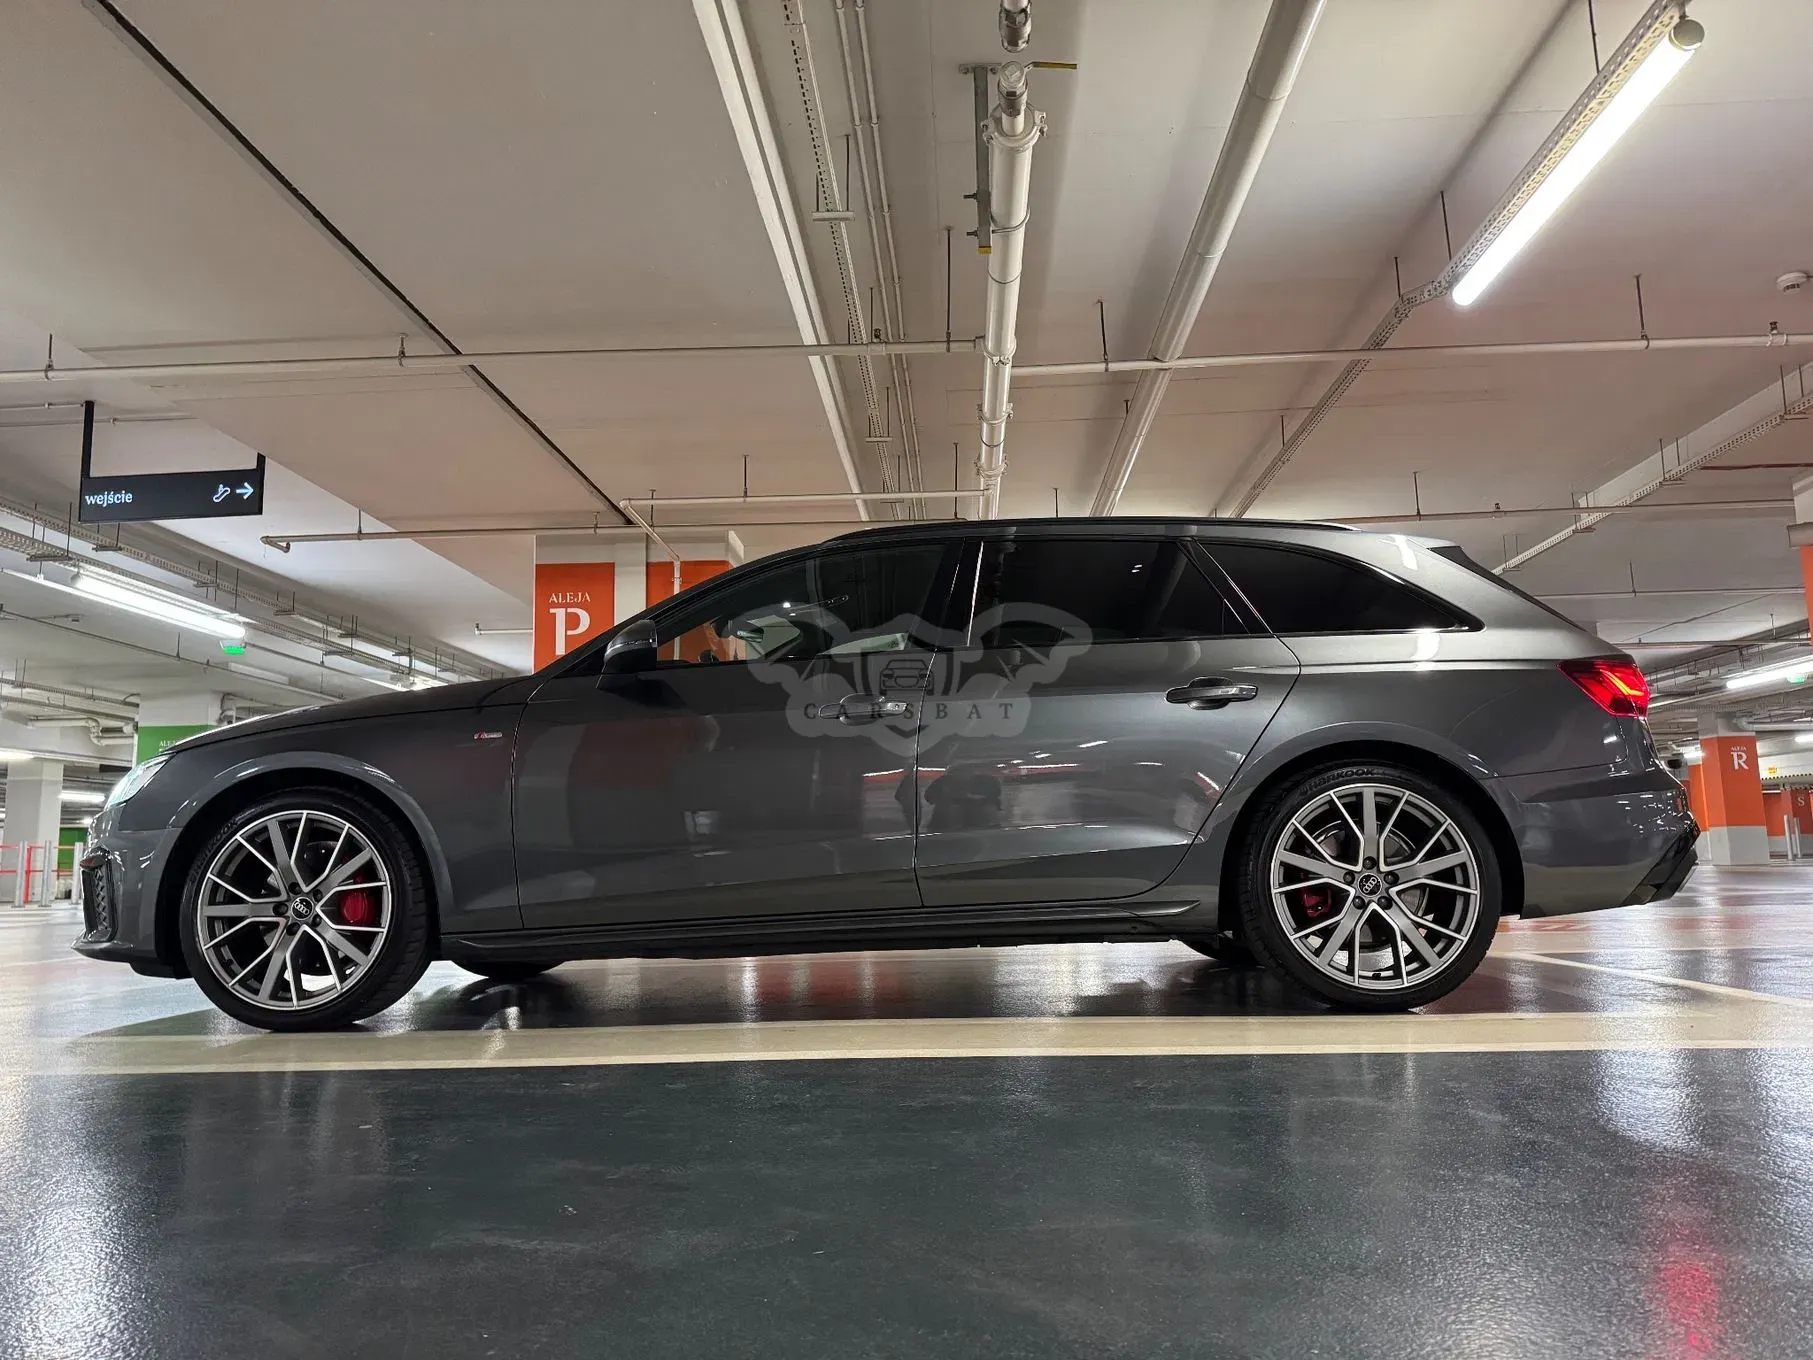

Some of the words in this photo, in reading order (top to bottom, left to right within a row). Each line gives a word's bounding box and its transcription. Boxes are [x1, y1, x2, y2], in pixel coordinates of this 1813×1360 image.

[85, 490, 133, 507] wejście
[549, 591, 591, 604] ALEJA
[549, 607, 591, 656] P
[1730, 751, 1750, 770] R
[1797, 796, 1805, 807] S
